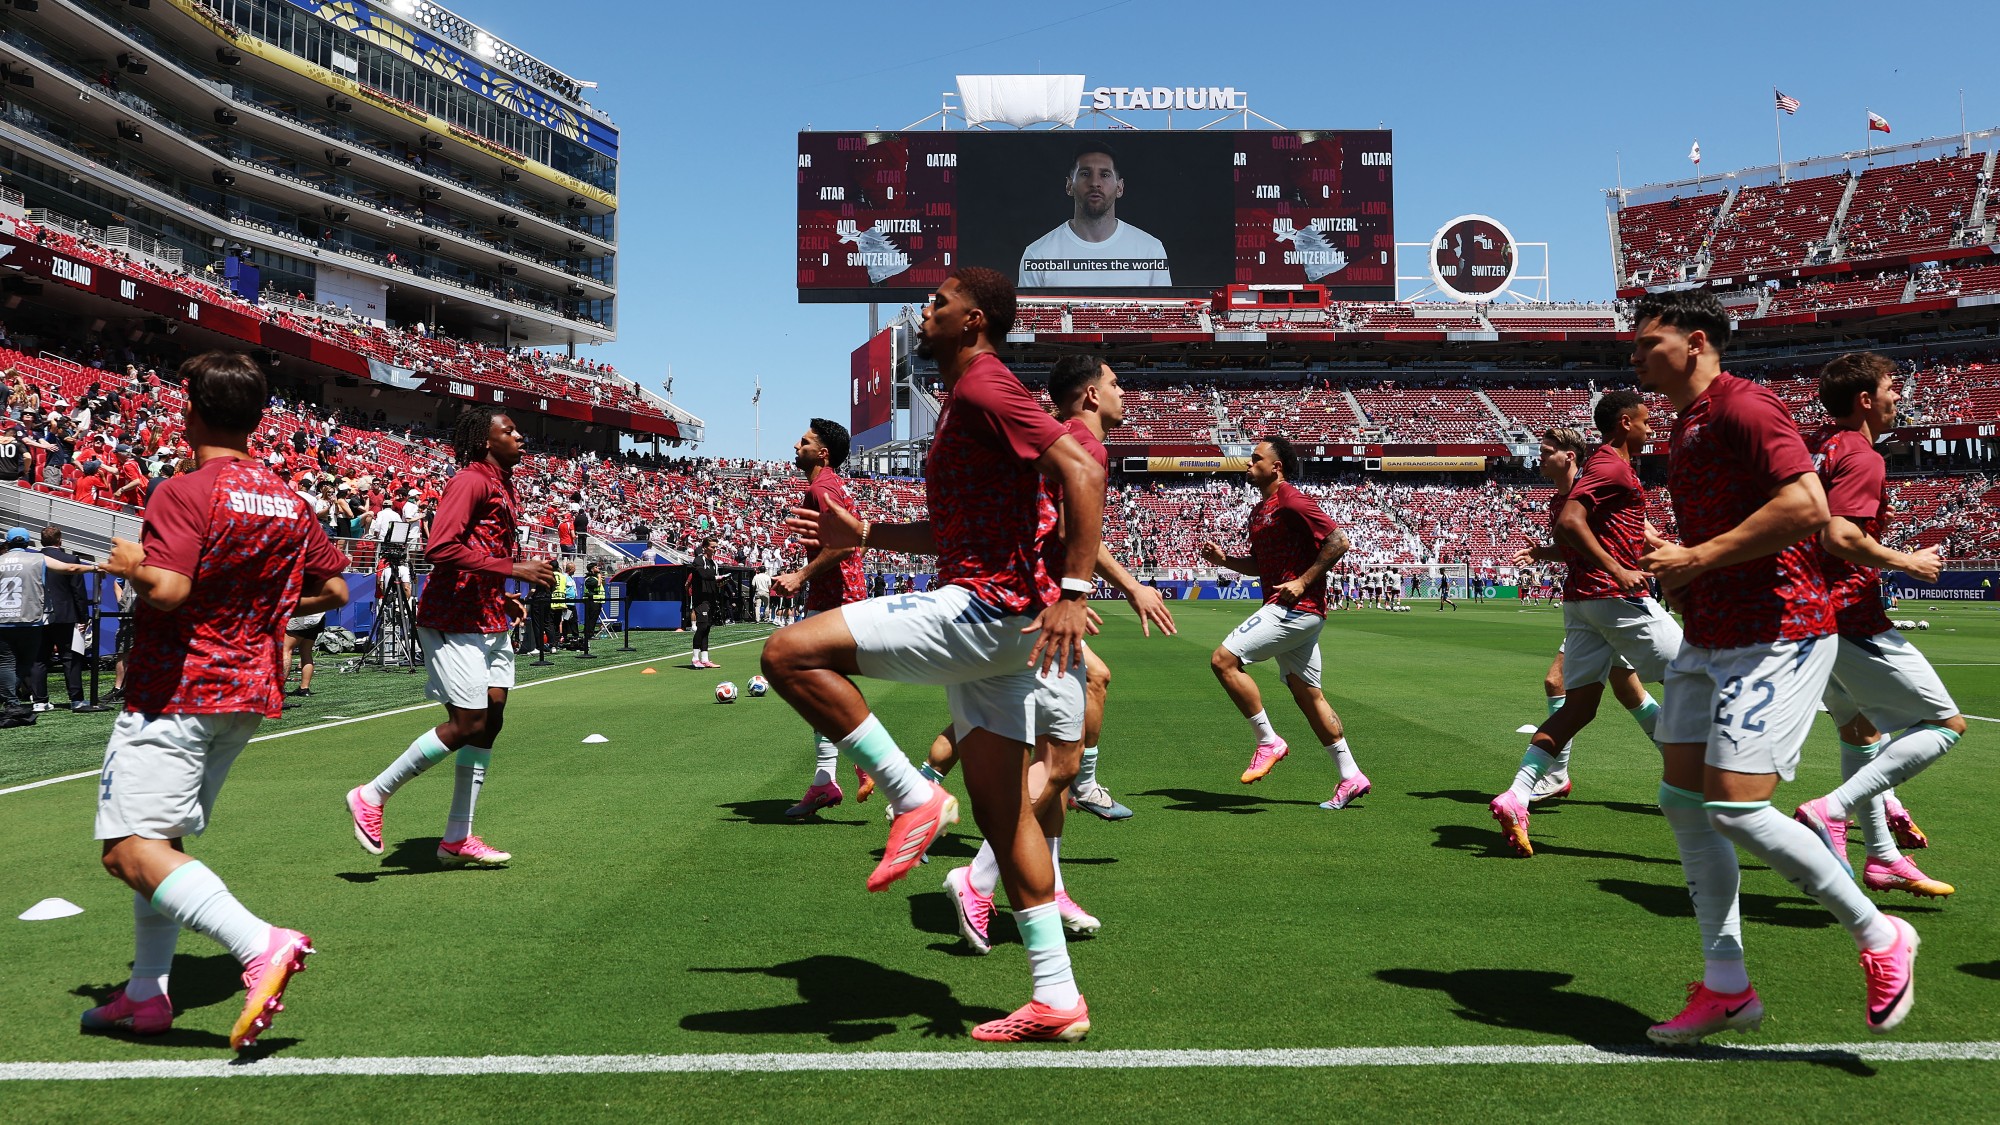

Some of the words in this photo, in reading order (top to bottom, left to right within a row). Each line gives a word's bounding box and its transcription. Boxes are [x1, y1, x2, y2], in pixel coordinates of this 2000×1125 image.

[1093, 86, 1235, 110] STADIUM
[798, 154, 811, 167] AR
[927, 154, 957, 166] QATAR
[1234, 152, 1246, 166] AR
[1362, 152, 1392, 166] QATAR
[875, 220, 921, 233] SWITZERL
[1311, 218, 1358, 231] SWITZERL
[847, 253, 908, 266] SWITZERLAN
[1284, 251, 1344, 264] SWITZERLAN
[52, 256, 91, 286] ZERLAND
[1024, 260, 1070, 270] Football
[1073, 260, 1108, 270] unites
[1110, 260, 1130, 270] the
[1132, 260, 1168, 270] world.
[1472, 266, 1505, 276] SWITZER
[120, 279, 136, 300] QAT
[188, 302, 199, 320] AR
[449, 381, 475, 397] ZERLAND
[1930, 428, 1942, 438] AR
[230, 492, 298, 520] SUISSE
[1216, 587, 1250, 600] VISA
[1921, 590, 1985, 599] PREDICTSTREET
[1239, 616, 1261, 633] 9
[1713, 676, 1775, 732] 22
